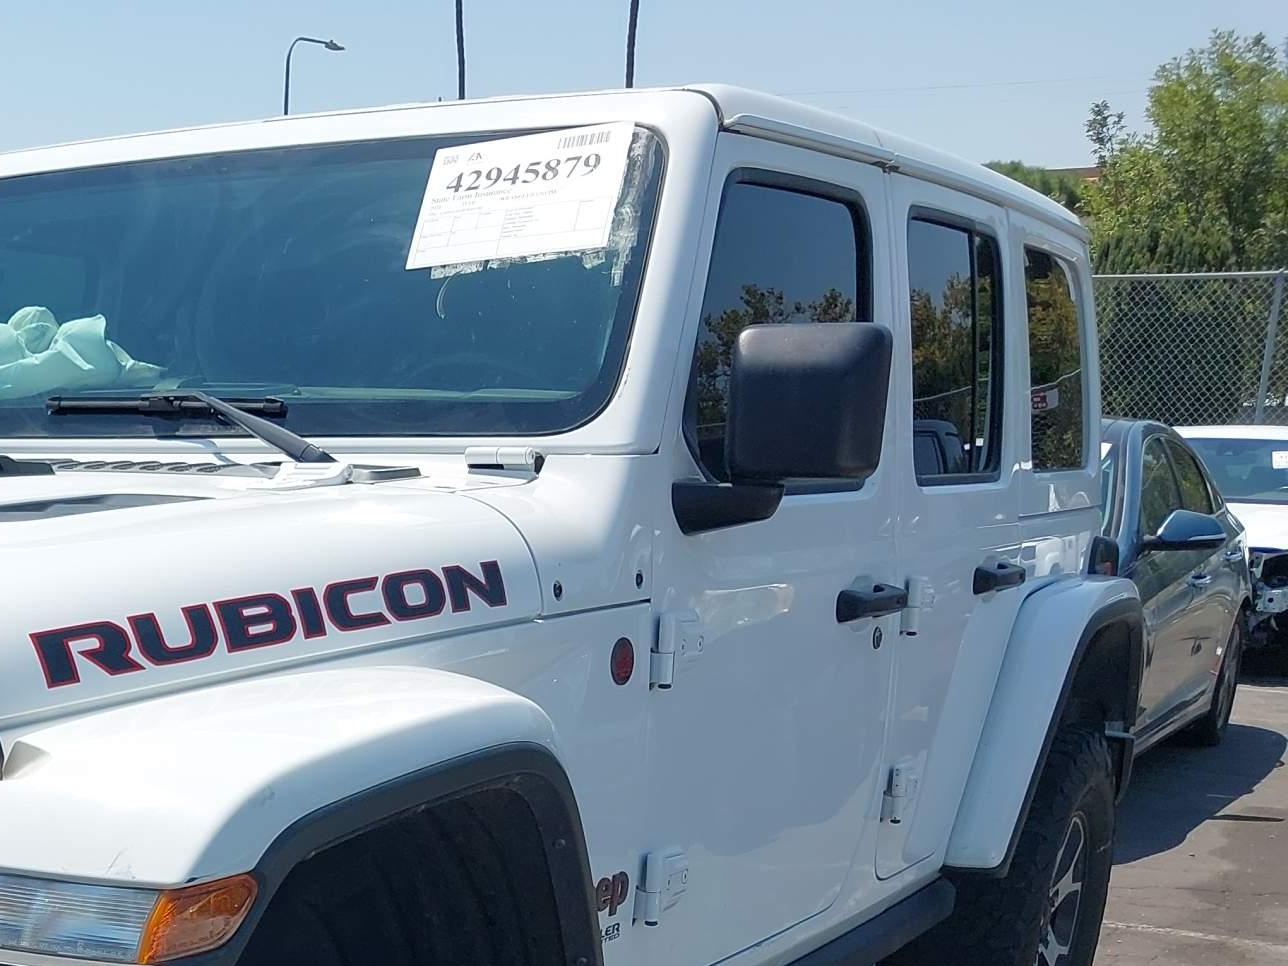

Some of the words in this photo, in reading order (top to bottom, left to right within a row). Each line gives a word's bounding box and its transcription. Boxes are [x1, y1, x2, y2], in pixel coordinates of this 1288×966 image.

[445, 153, 602, 193] 42945879
[29, 559, 508, 689] RUBICON
[595, 870, 630, 917] ep
